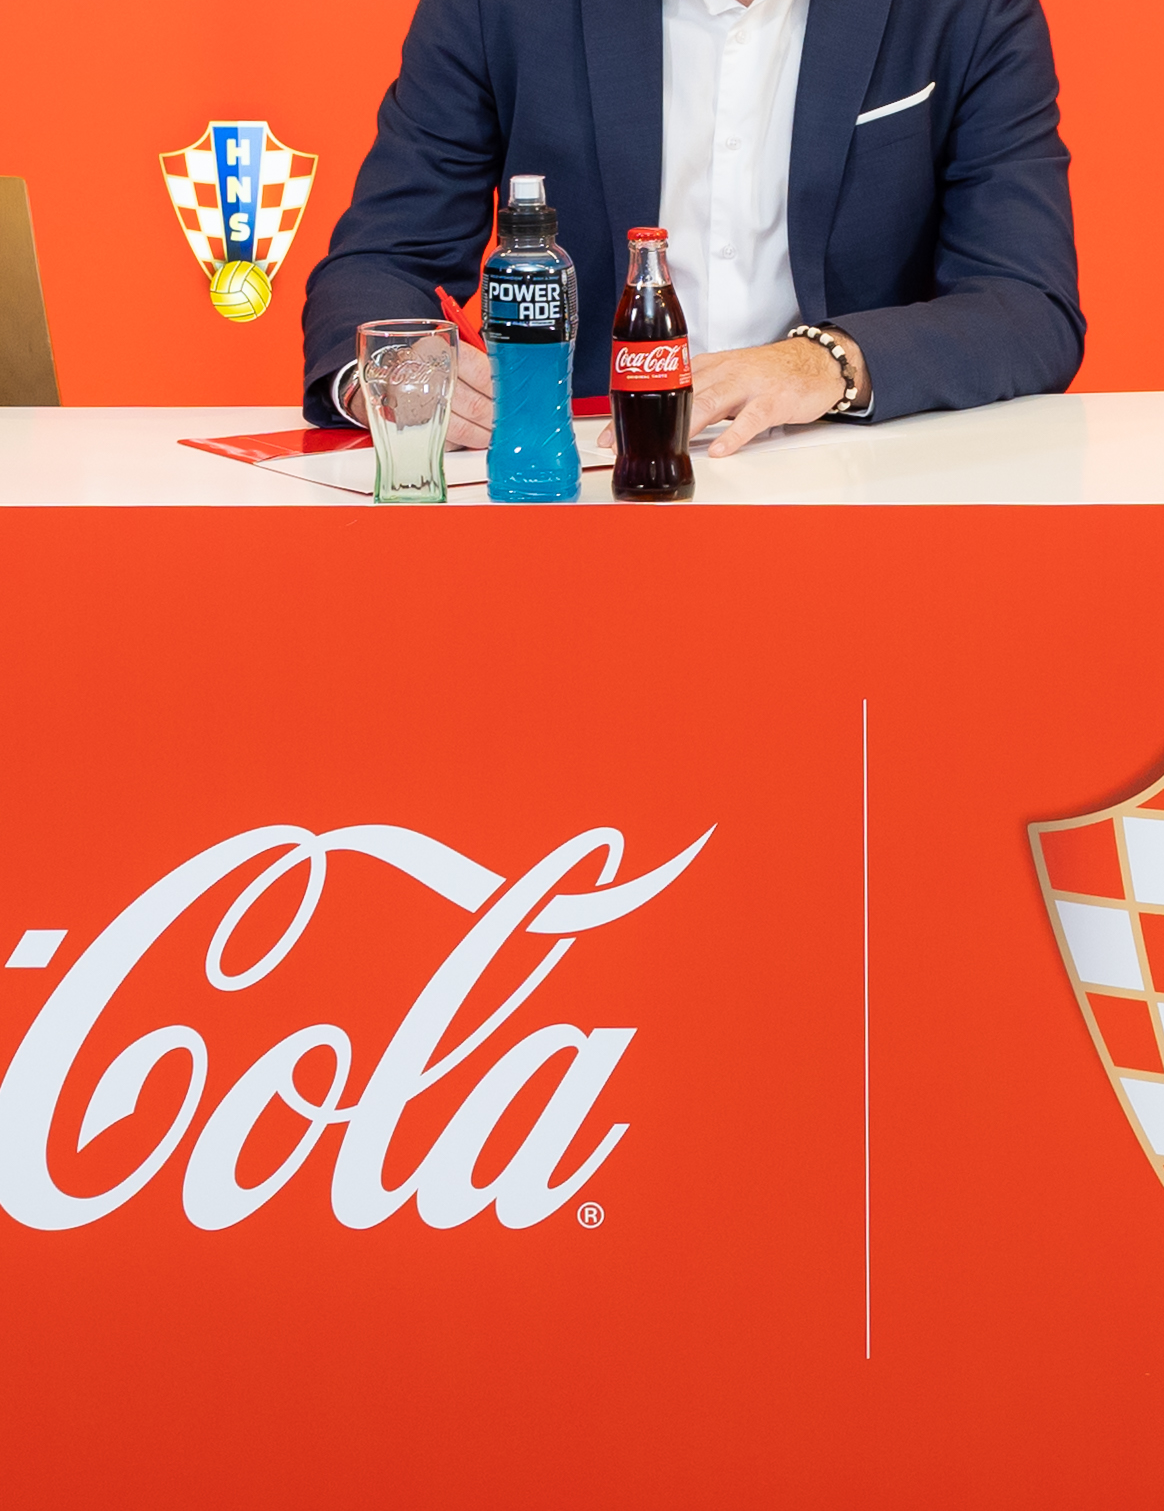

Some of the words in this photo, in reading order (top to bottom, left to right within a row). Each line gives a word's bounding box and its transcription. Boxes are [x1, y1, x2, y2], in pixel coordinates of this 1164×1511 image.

[226, 139, 252, 242] HNS
[489, 282, 561, 301] POWER
[519, 301, 561, 320] ADE
[615, 345, 681, 373] Coca-Cola
